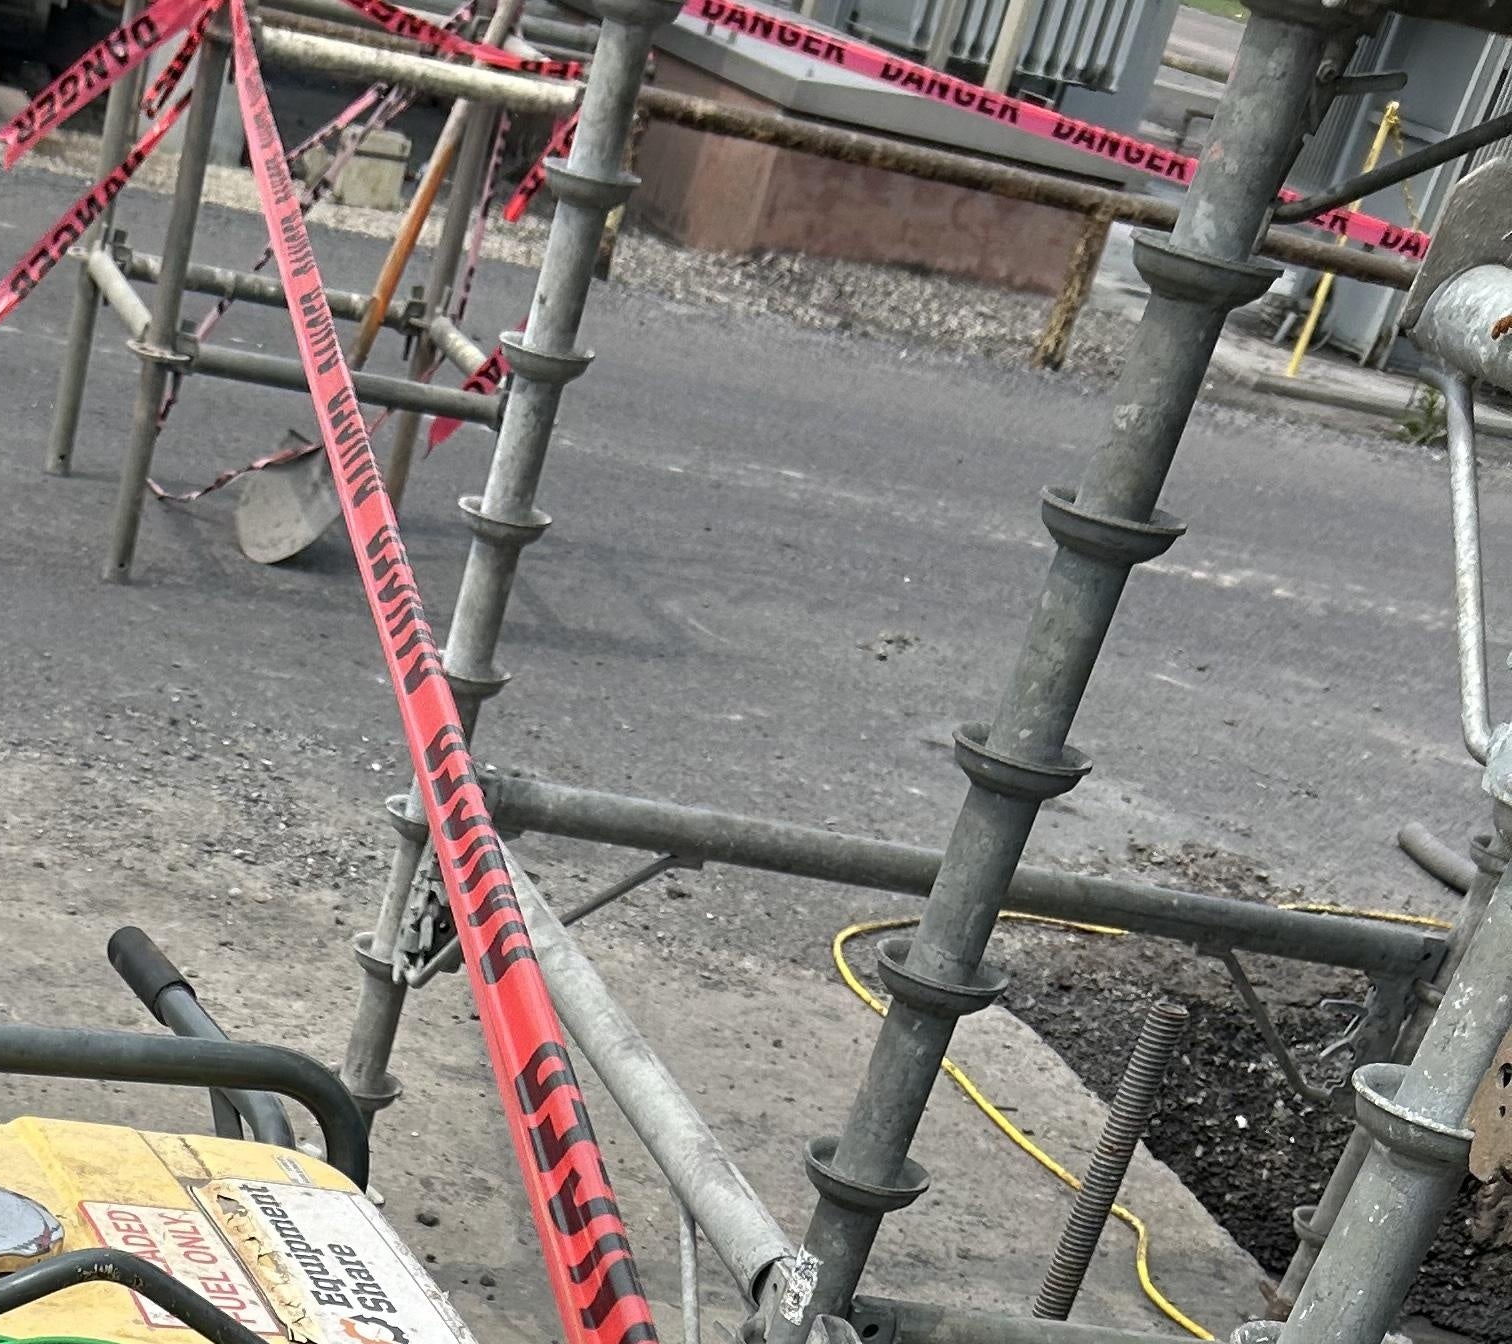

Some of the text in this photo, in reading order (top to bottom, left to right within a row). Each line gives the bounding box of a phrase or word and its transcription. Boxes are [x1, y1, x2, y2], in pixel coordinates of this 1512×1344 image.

[13, 14, 162, 144] DANGER
[699, 0, 847, 65] DANGER
[878, 61, 1020, 125] DANGER
[1050, 115, 1189, 182] DANGER
[158, 1211, 218, 1266] ONLY
[239, 1183, 353, 1310] Equipment
[327, 1242, 398, 1315] Share
